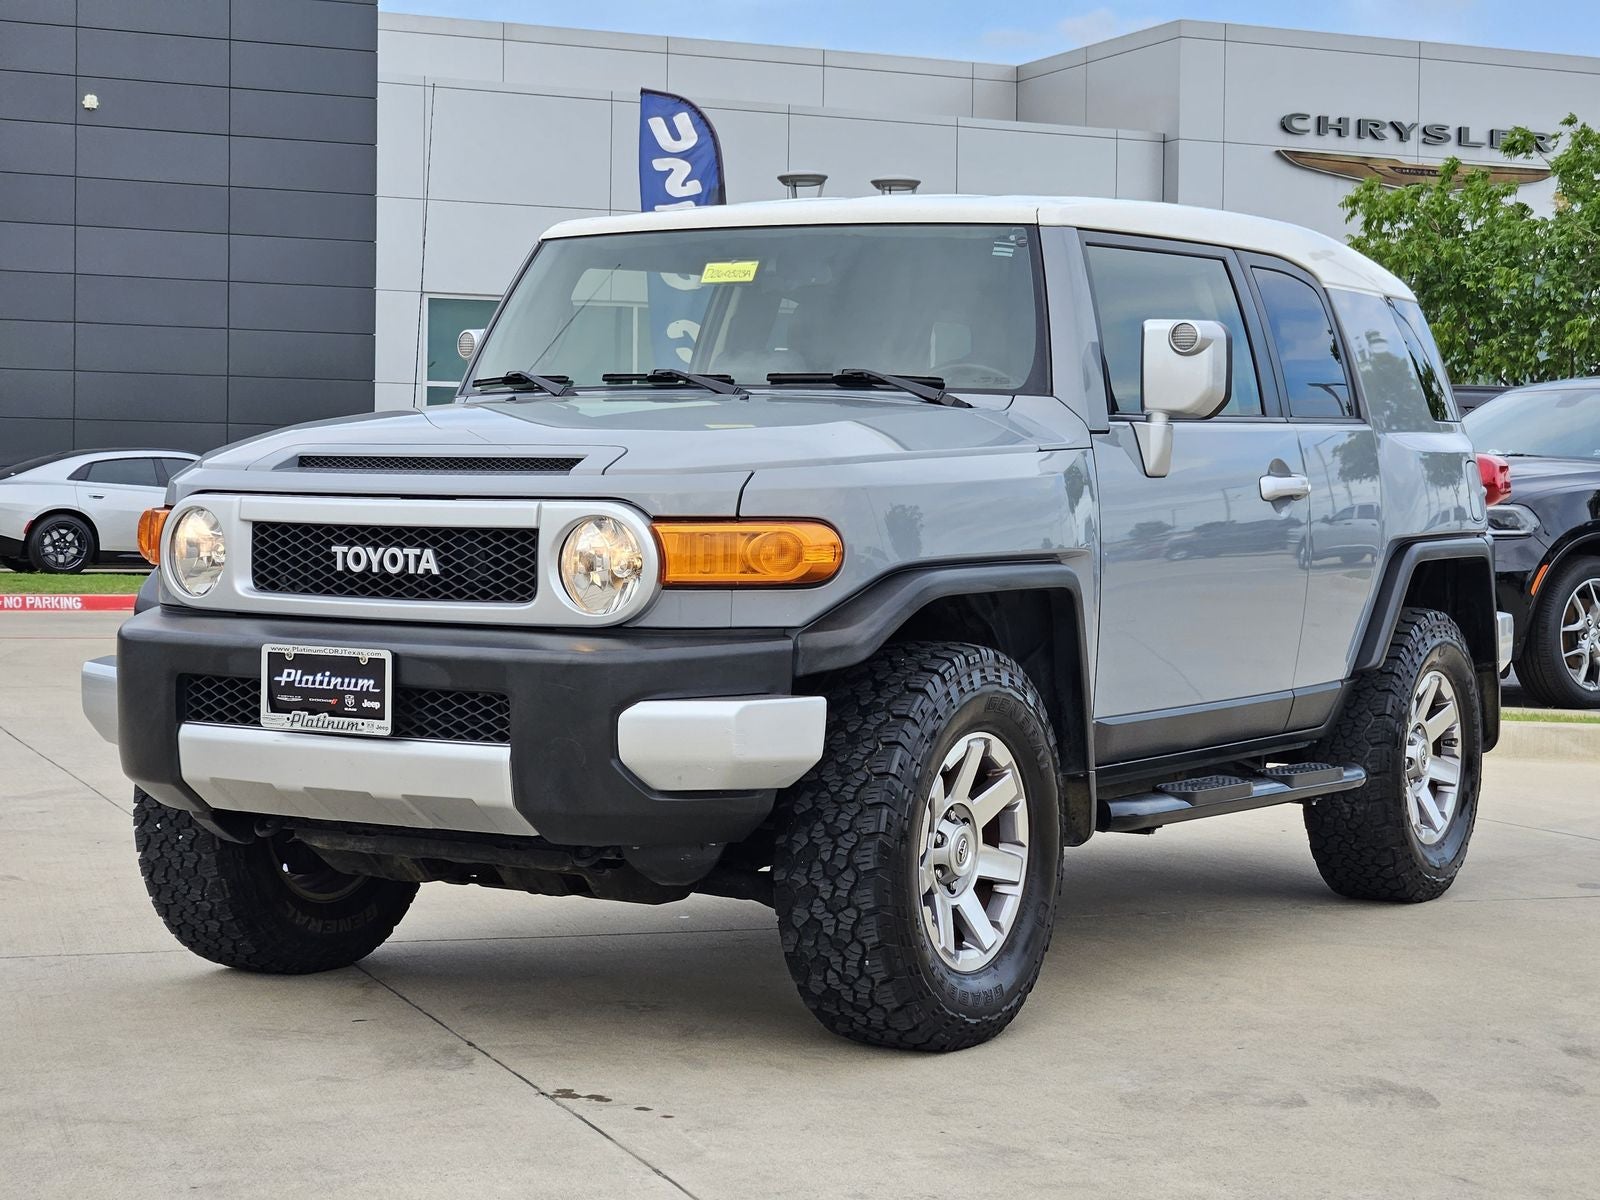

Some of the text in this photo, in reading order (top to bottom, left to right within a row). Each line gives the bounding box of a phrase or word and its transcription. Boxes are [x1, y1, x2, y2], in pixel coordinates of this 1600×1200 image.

[330, 545, 441, 575] TOYOTA
[3, 596, 82, 609] NO PARKING
[273, 669, 381, 693] Platinum
[362, 699, 381, 709] Jeep
[289, 712, 361, 731] Platinum
